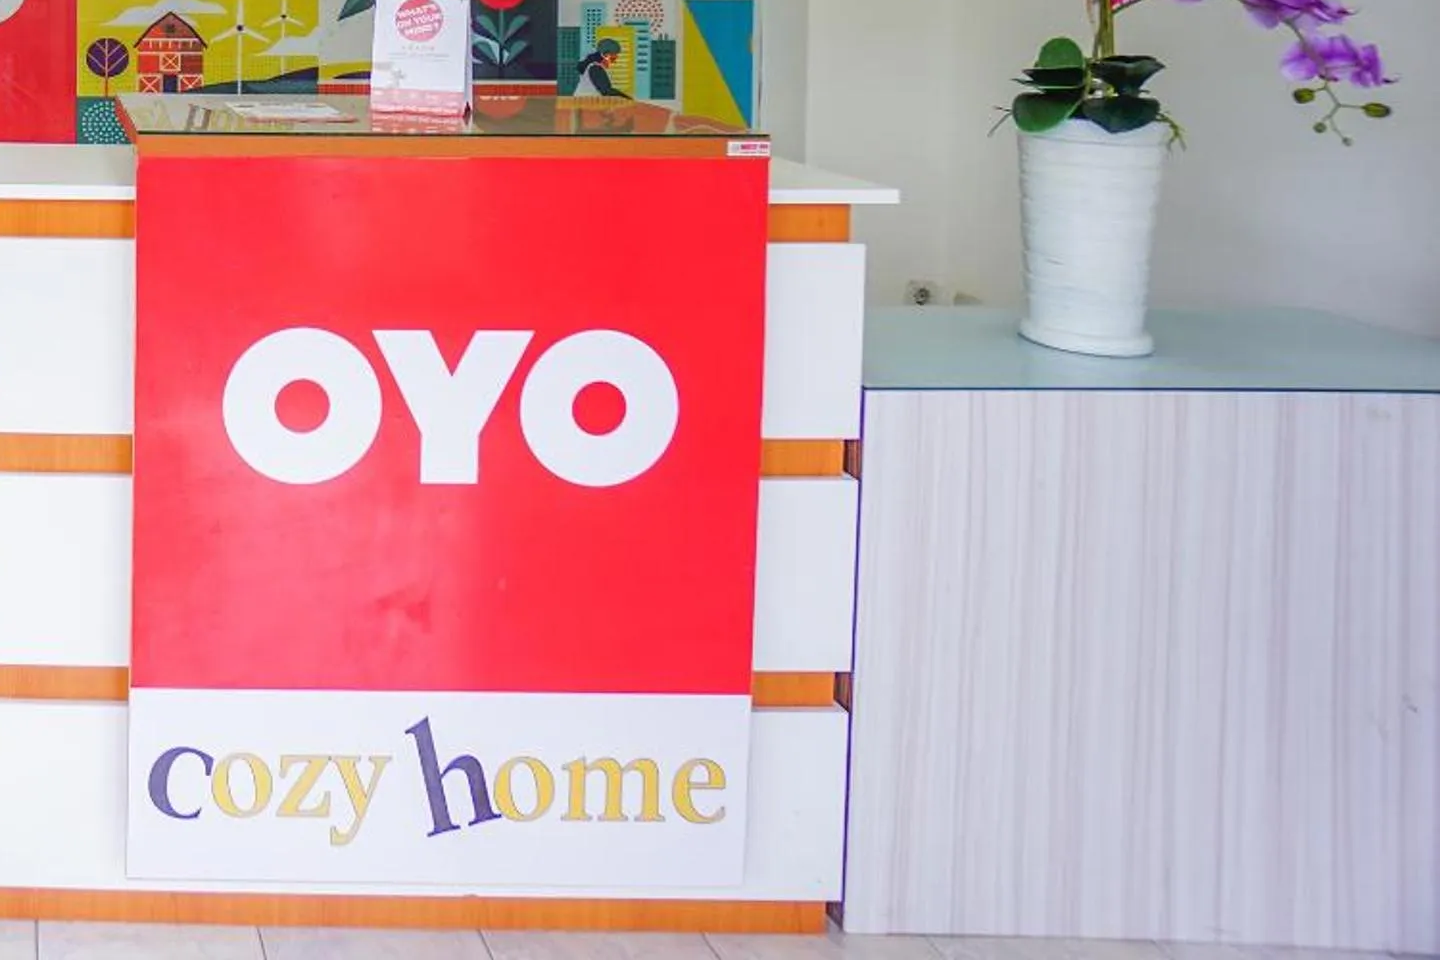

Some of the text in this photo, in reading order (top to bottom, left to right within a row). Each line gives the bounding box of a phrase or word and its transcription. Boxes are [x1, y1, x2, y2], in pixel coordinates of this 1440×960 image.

[222, 326, 679, 487] OYO
[148, 715, 726, 846] cozy home
